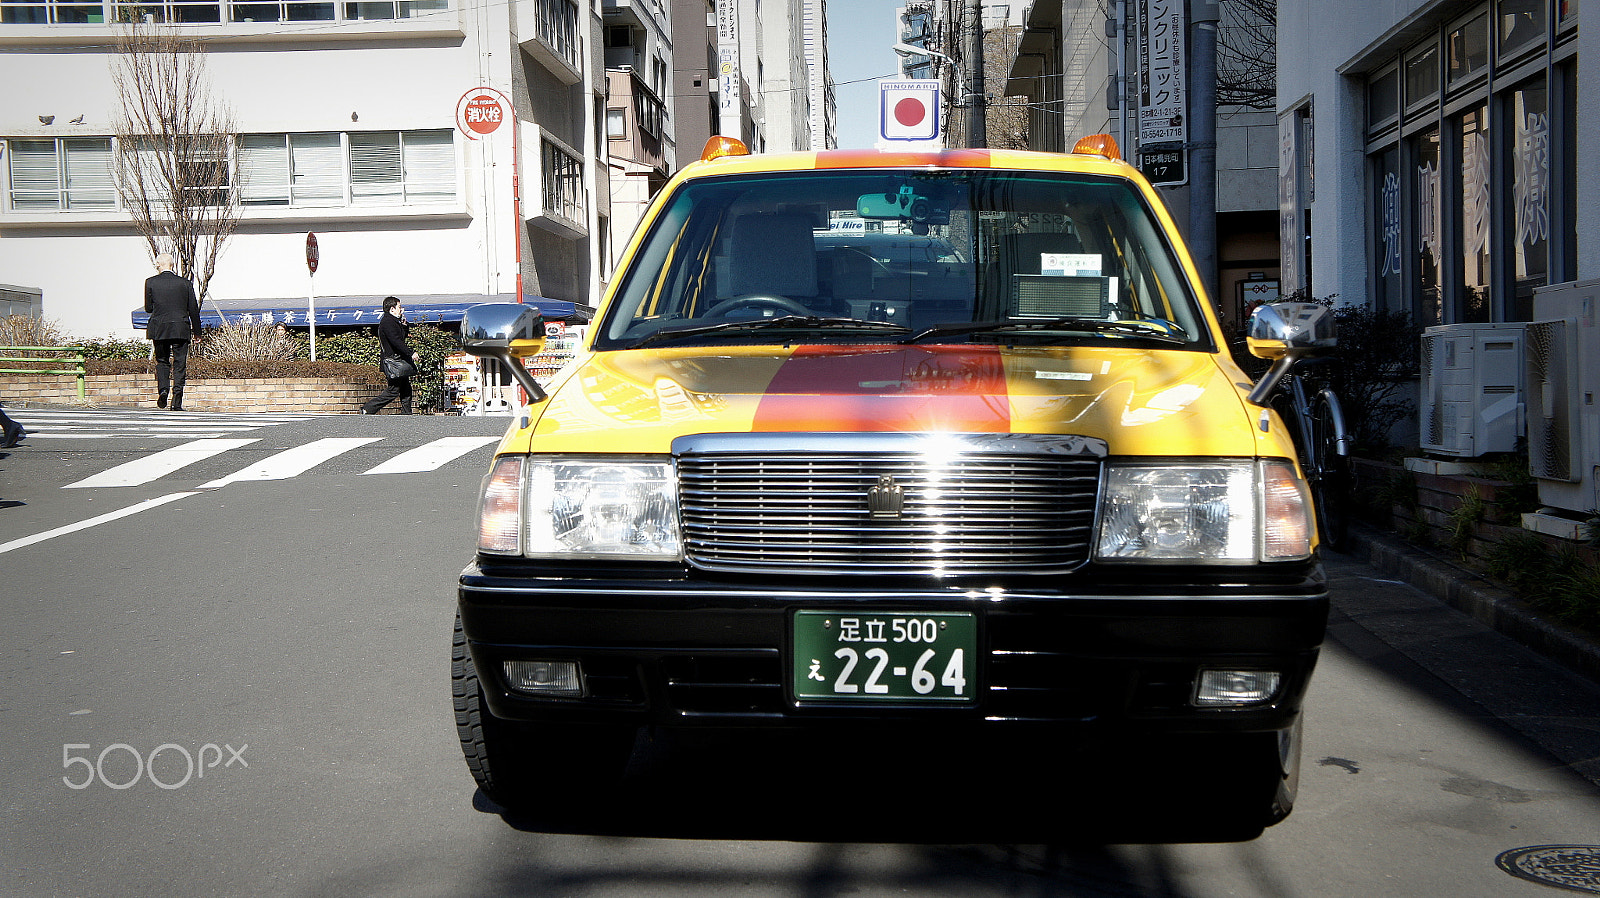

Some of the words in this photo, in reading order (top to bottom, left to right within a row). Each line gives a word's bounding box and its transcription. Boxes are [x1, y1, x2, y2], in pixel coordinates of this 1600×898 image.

[1153, 0, 1170, 105] ンクリニック
[467, 107, 501, 122] 消火栓
[1142, 128, 1182, 139] 03-5542-1718
[1153, 166, 1168, 176] 17
[842, 221, 863, 229] Hire
[807, 659, 825, 682] え
[834, 647, 966, 695] 22-64
